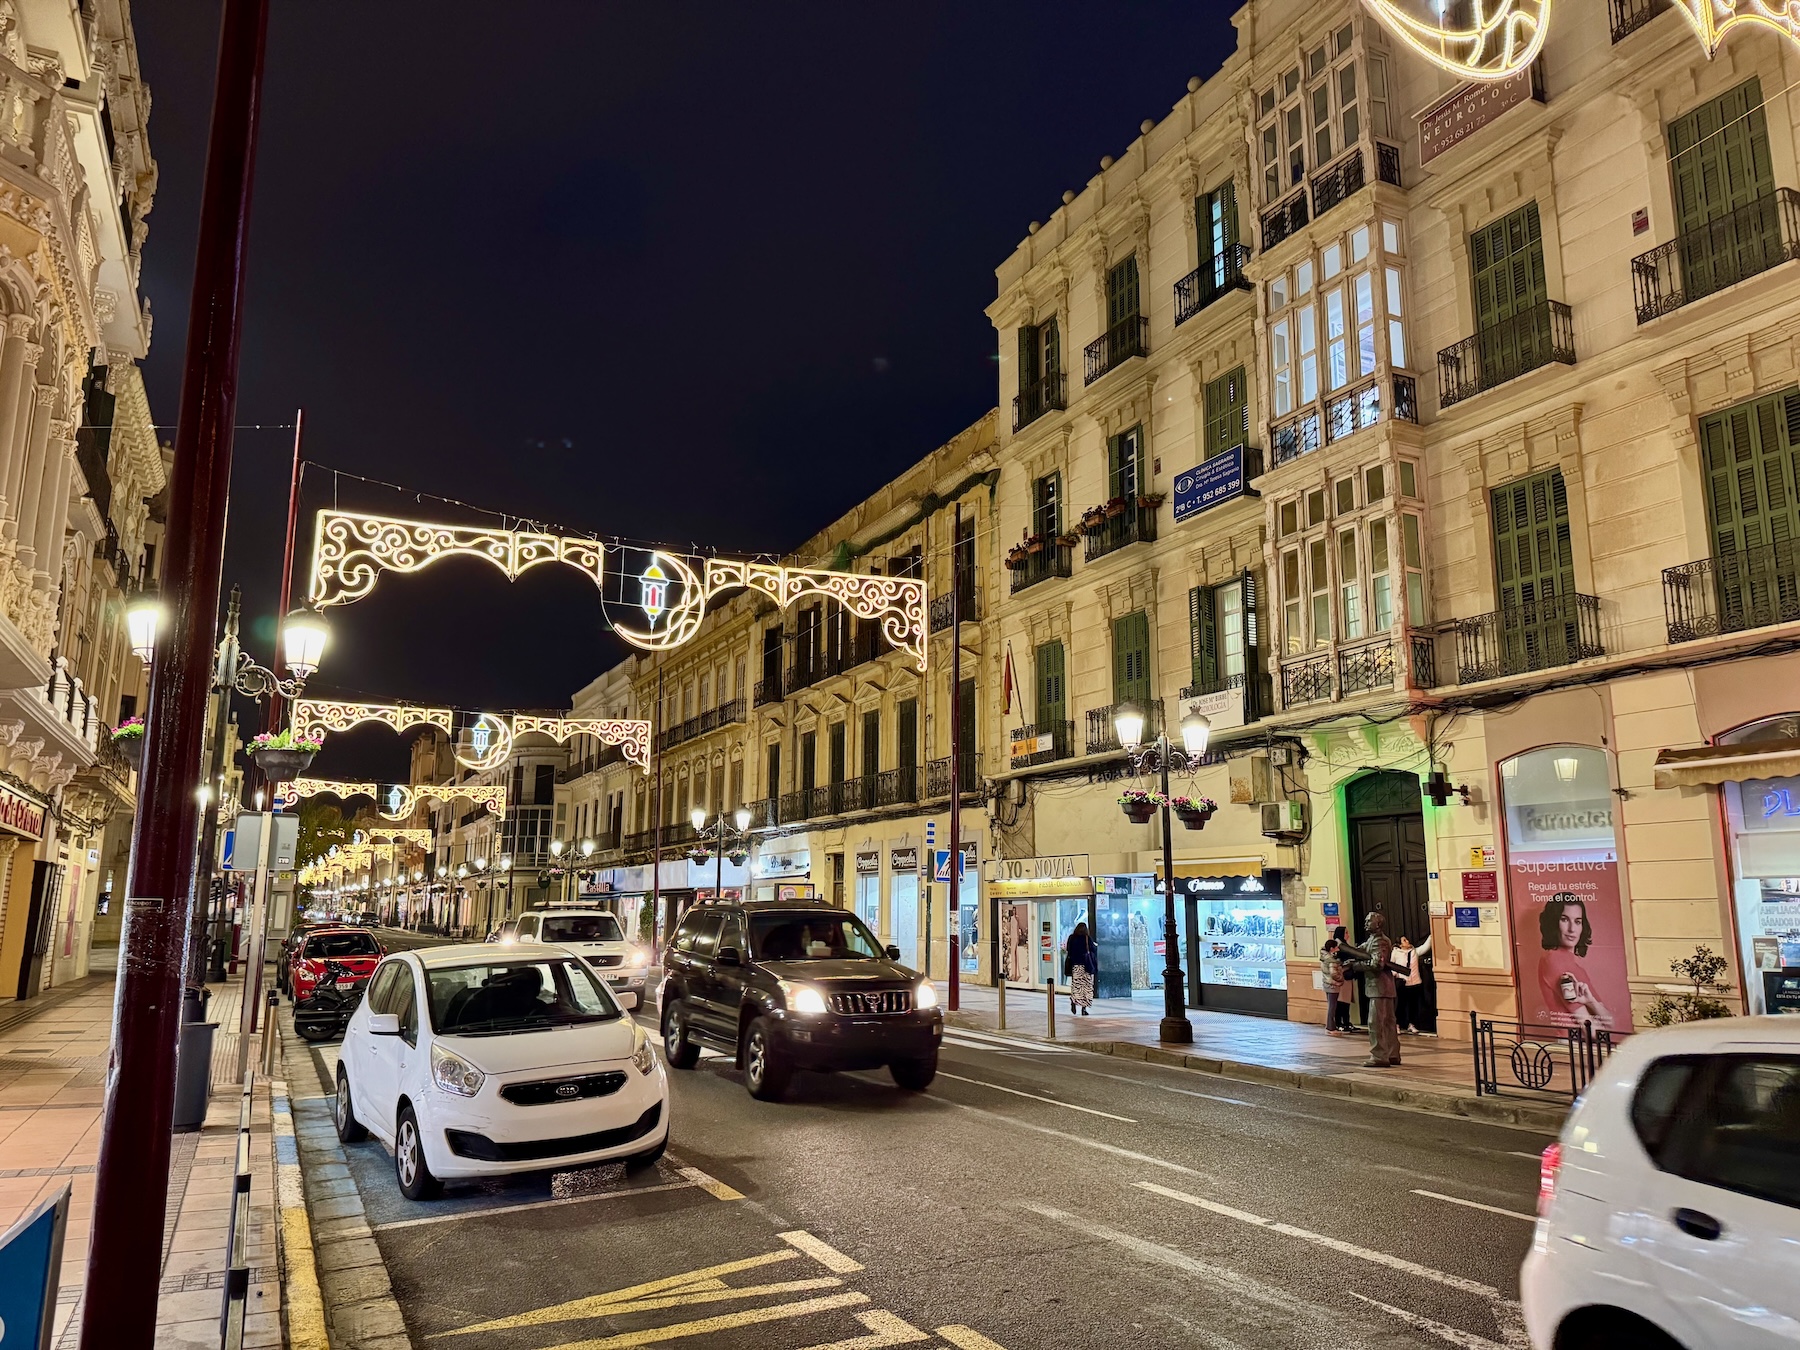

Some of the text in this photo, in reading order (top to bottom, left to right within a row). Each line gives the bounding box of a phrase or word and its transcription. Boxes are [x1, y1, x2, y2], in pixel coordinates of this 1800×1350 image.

[1423, 121, 1433, 131] Dr.
[1435, 109, 1451, 124] Jesús
[1463, 82, 1491, 104] Romero
[1423, 71, 1525, 143] NEURÓLOGO
[1432, 145, 1440, 153] T.
[1440, 134, 1454, 149] 952
[1455, 128, 1464, 139] 68
[1465, 121, 1474, 133] 21
[1476, 114, 1486, 126] 72
[1510, 93, 1517, 103] C
[1202, 490, 1214, 502] 952
[1214, 484, 1227, 496] 685
[1227, 479, 1240, 491] 399
[1006, 861, 1022, 878] YO
[1034, 857, 1075, 877] NOVIA
[1517, 857, 1607, 876] Superlativa
[1528, 881, 1598, 892] Regula tu estrés.
[1531, 892, 1597, 902] Toma el control.
